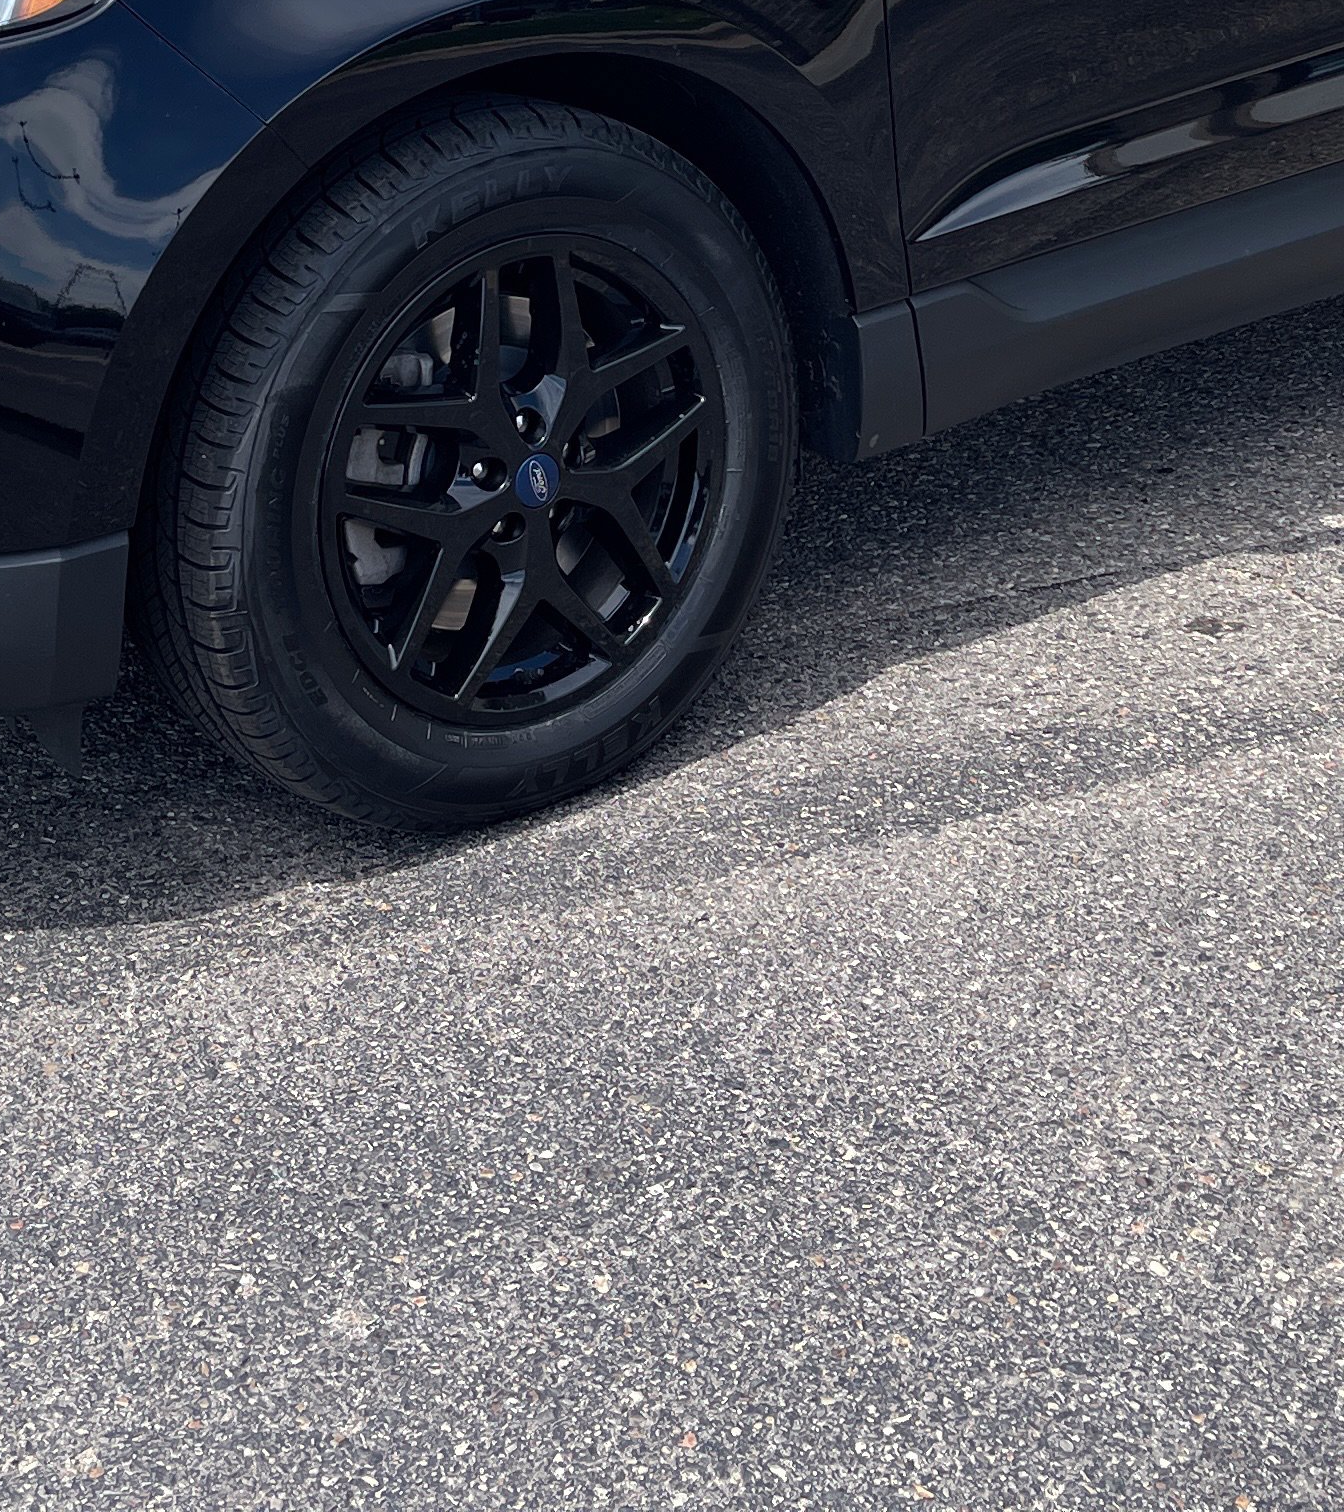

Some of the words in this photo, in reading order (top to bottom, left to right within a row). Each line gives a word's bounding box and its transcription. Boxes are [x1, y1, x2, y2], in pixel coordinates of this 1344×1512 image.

[411, 165, 574, 250] KELLY
[272, 414, 290, 459] PLUS
[506, 695, 664, 798] KELLY
